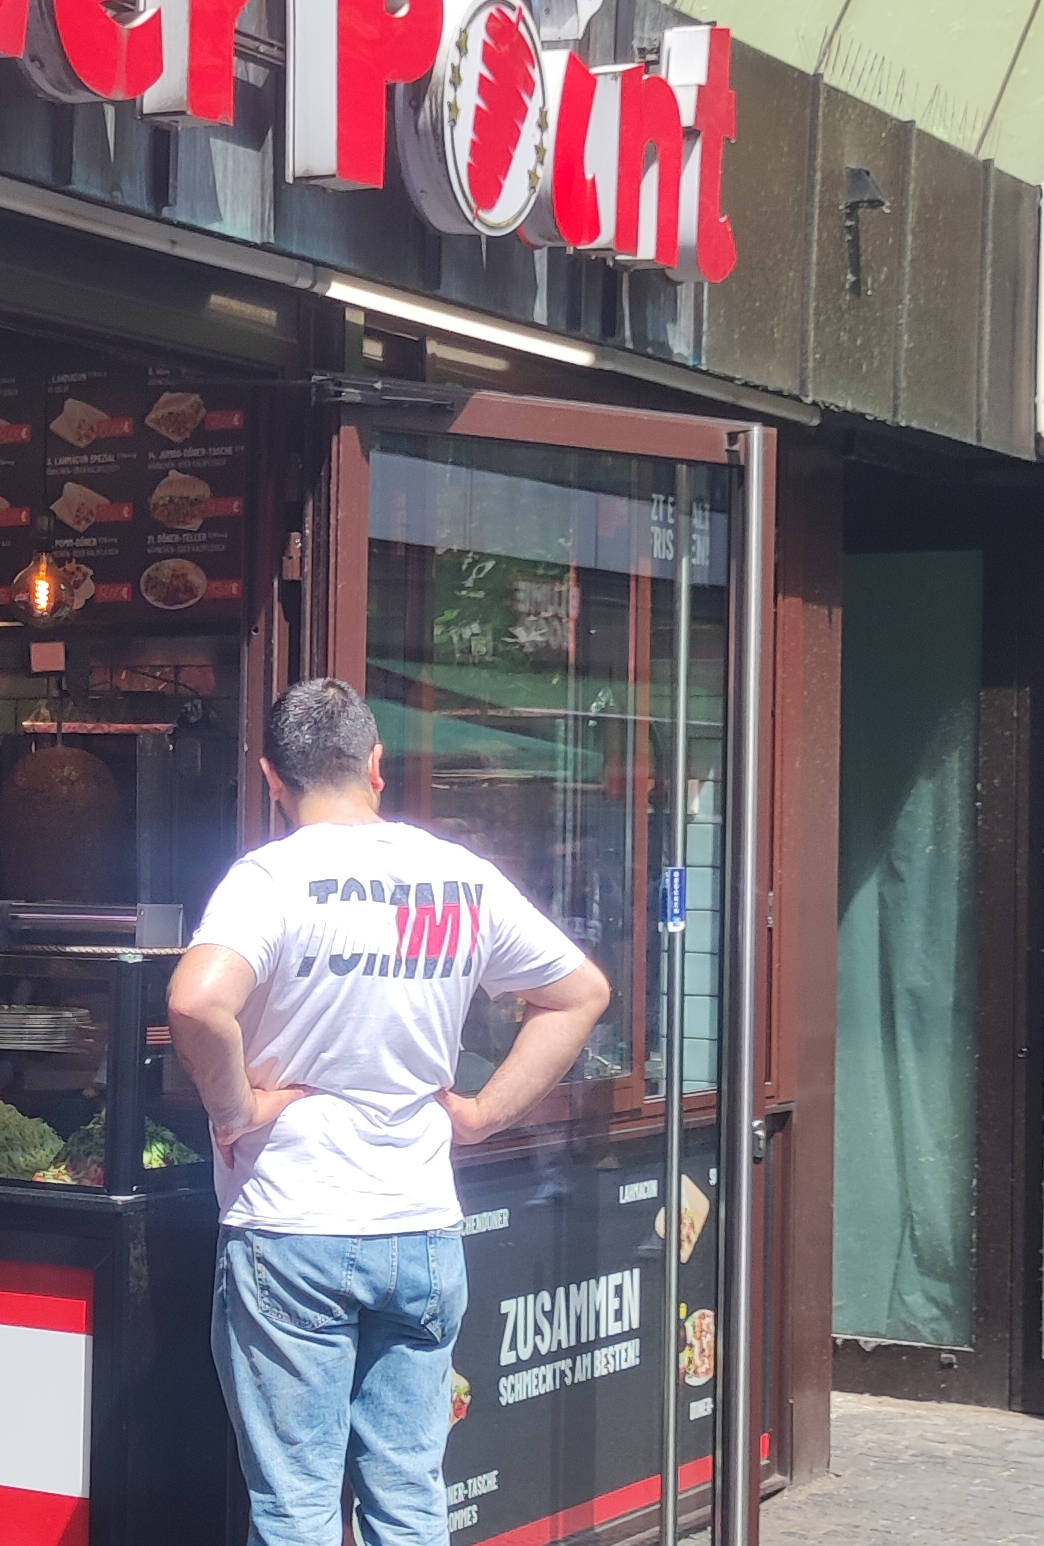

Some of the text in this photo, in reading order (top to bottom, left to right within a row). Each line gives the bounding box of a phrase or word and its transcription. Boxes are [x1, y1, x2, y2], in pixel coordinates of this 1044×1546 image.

[499, 1267, 641, 1366] ZUSAMMEN
[498, 1338, 641, 1406] SCHMECKT'S AM BESTEN!
